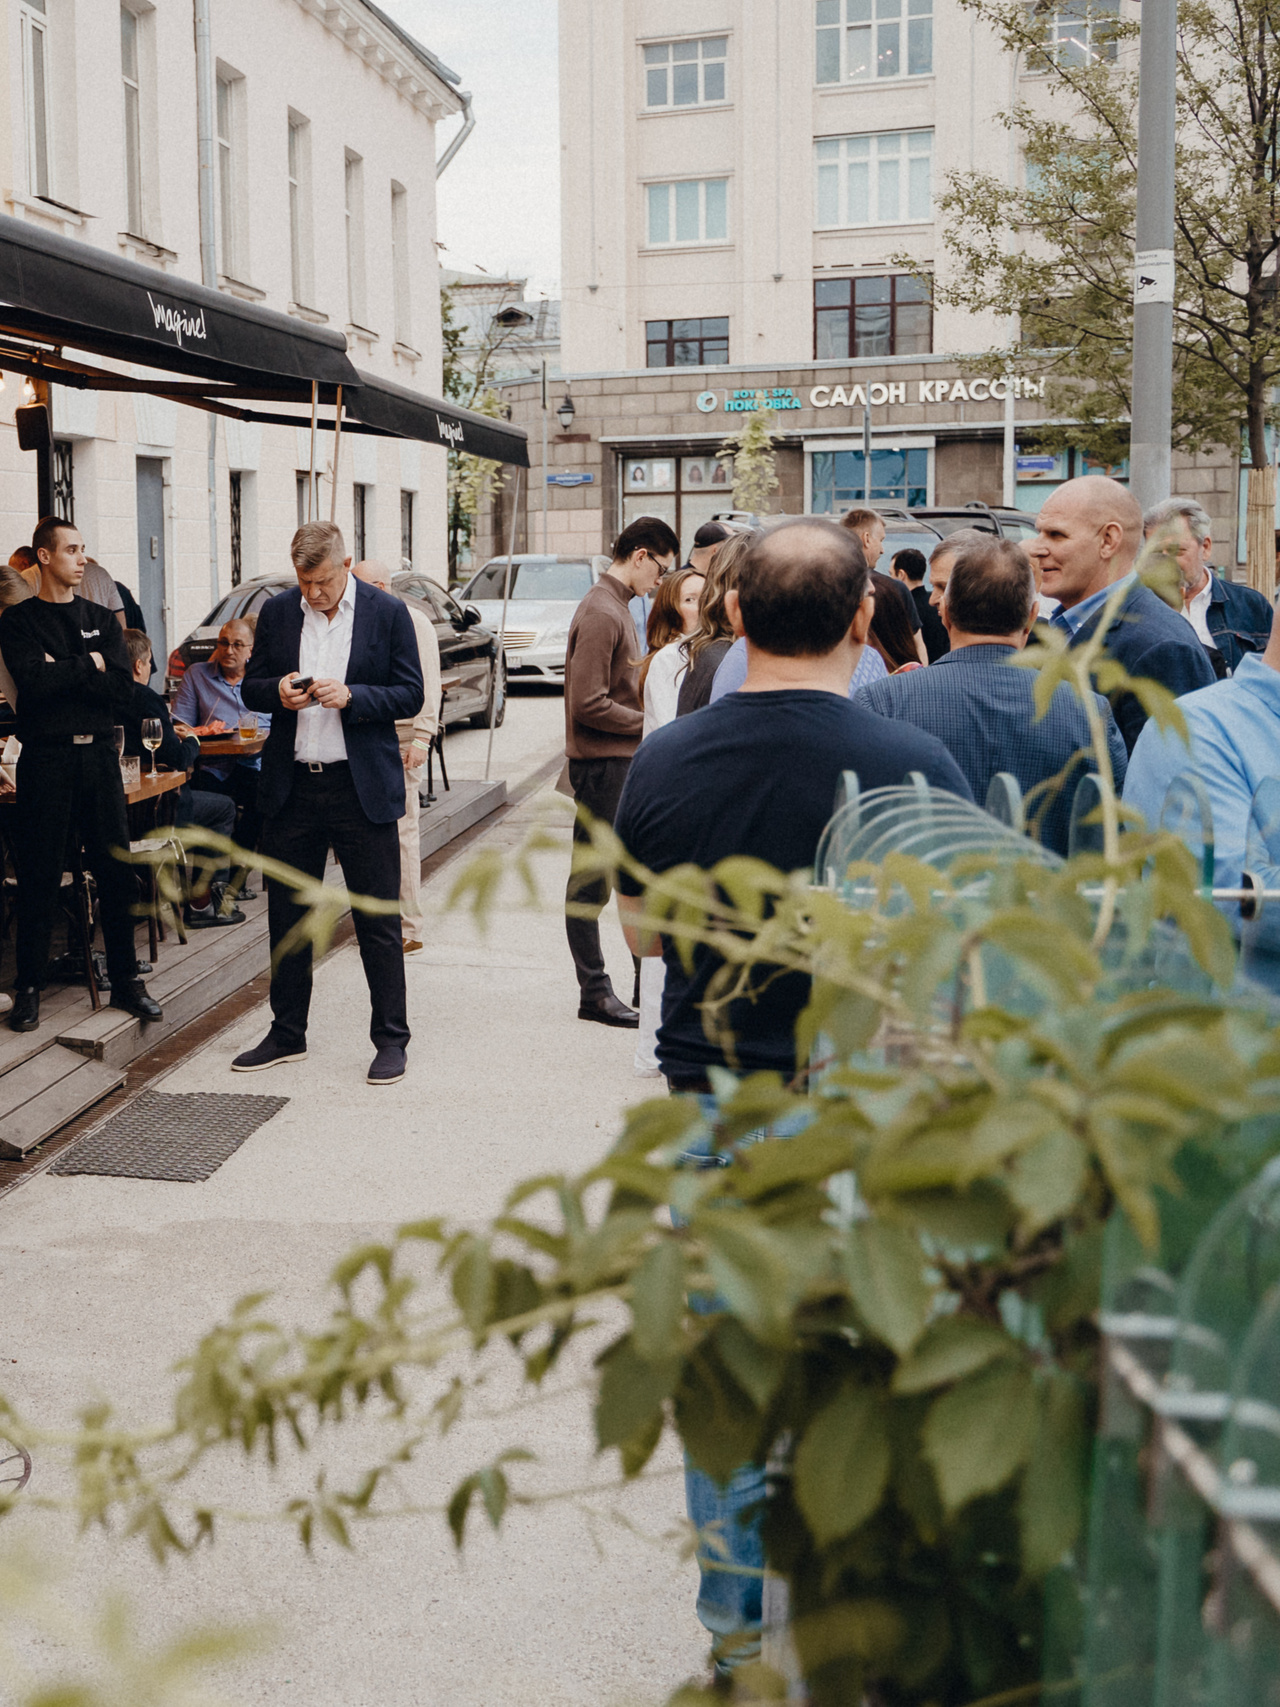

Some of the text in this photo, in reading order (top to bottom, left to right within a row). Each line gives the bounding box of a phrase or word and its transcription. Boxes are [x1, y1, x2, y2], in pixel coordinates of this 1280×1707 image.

[147, 291, 207, 346] Imagine!
[733, 388, 793, 399] ROYL SPA
[809, 381, 906, 408] САЛОН
